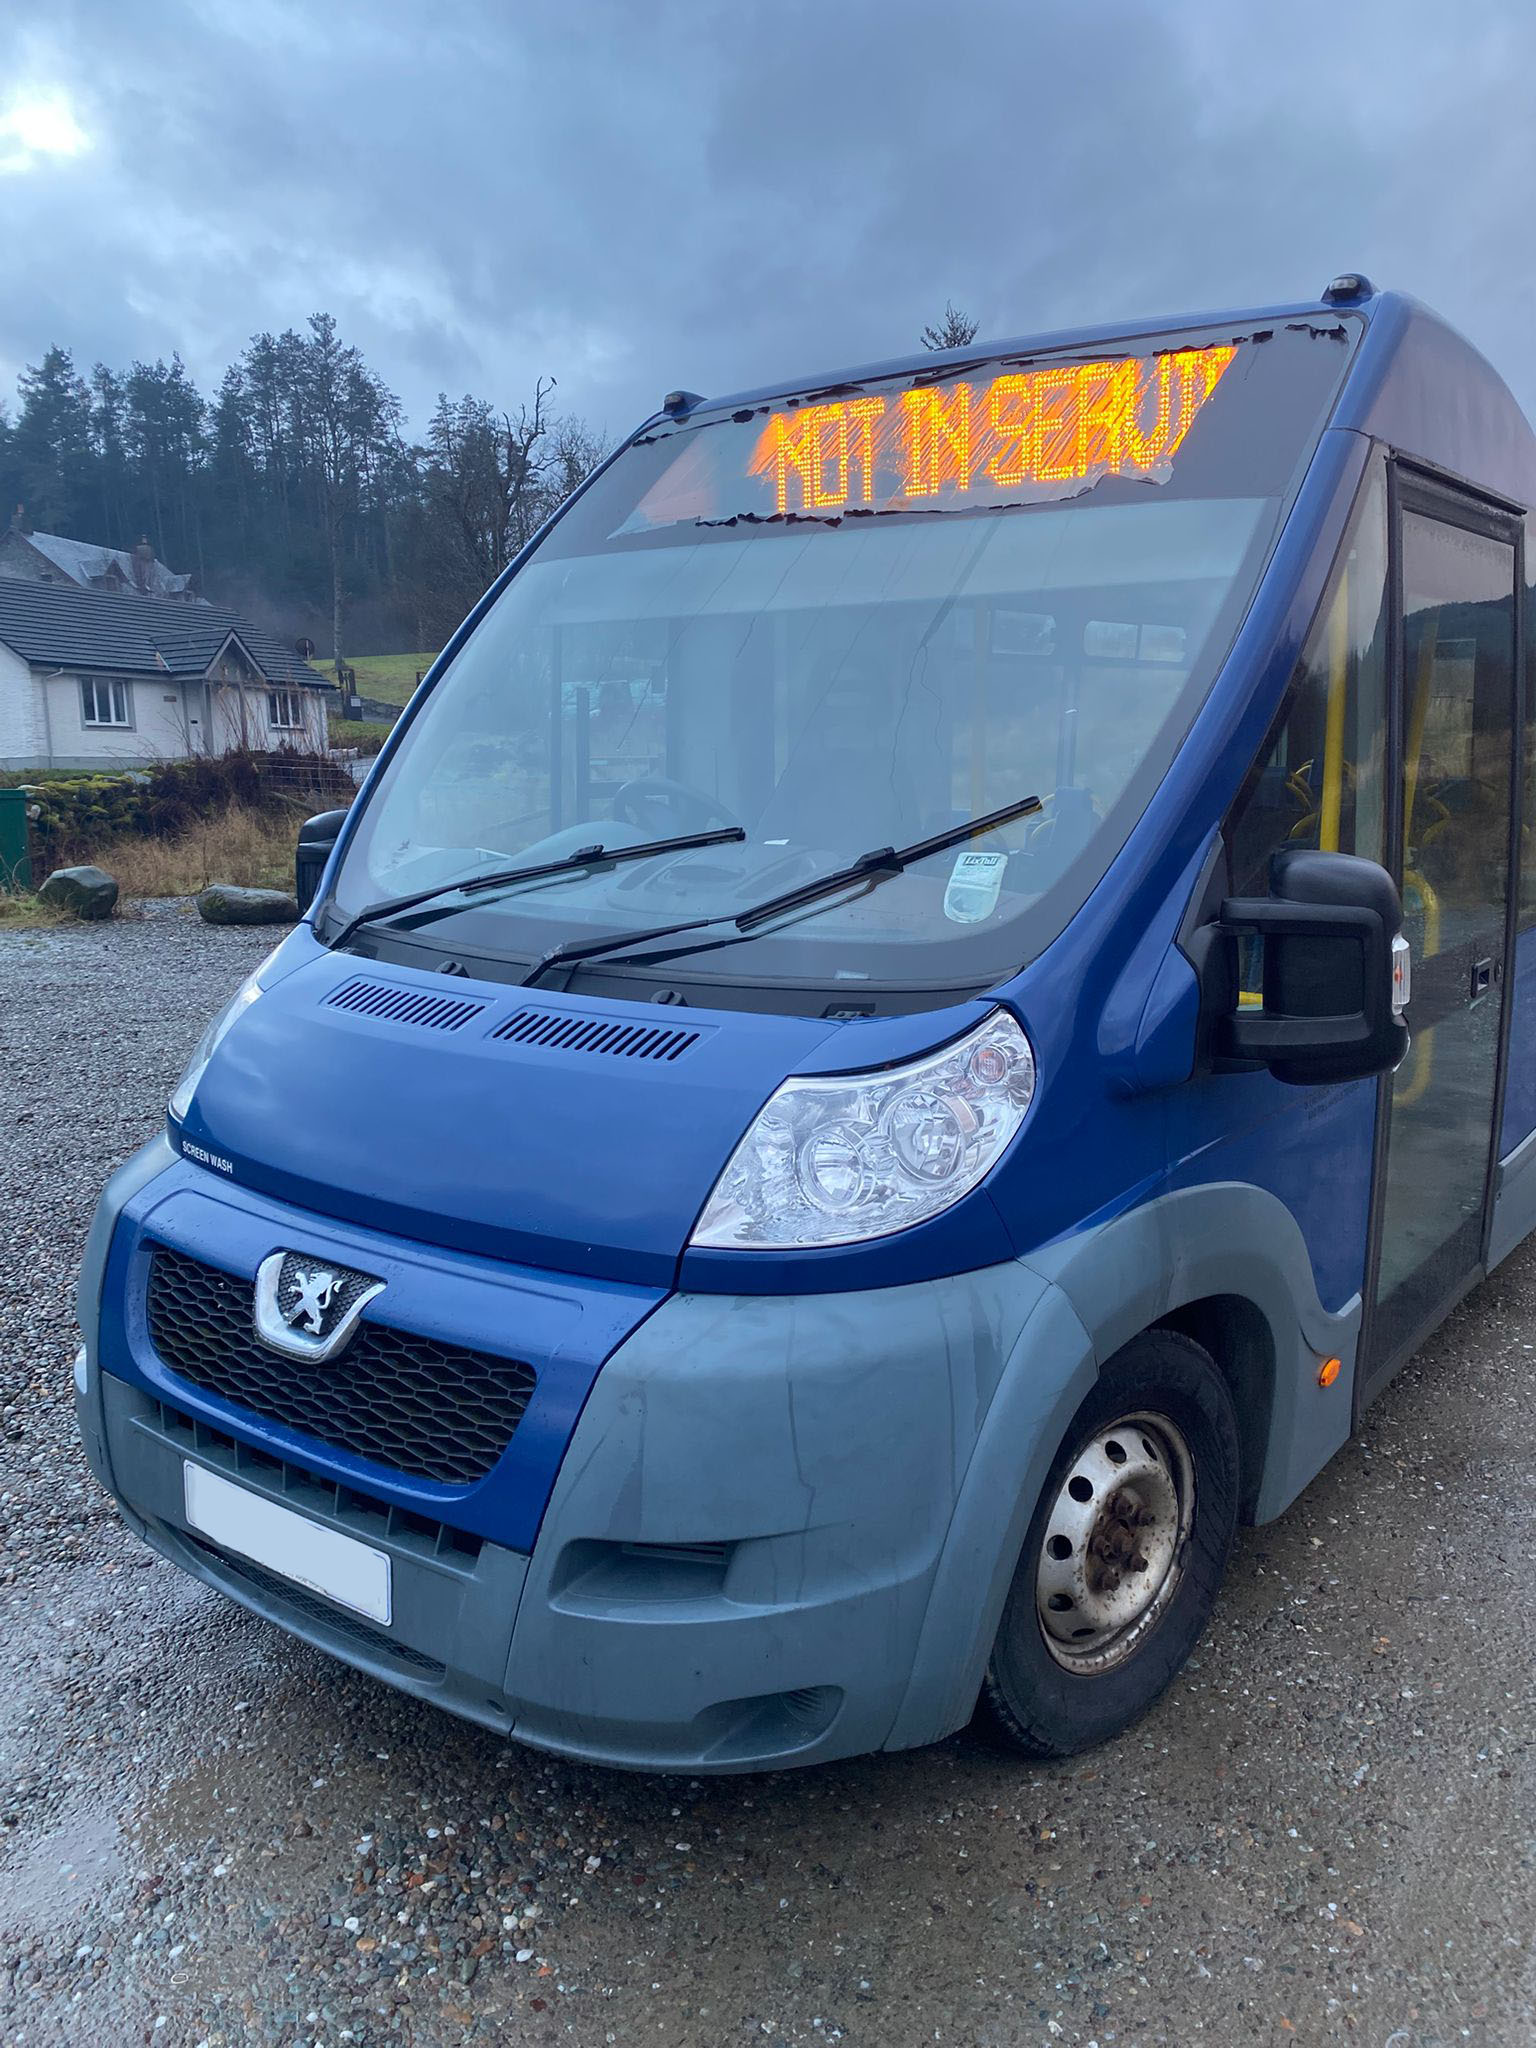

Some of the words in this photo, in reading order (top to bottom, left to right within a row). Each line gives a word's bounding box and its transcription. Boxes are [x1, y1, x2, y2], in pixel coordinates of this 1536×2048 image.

[776, 400, 886, 513] NOT
[904, 383, 969, 497] IN
[182, 1140, 210, 1164] SCREEN
[209, 1153, 233, 1174] WASH
